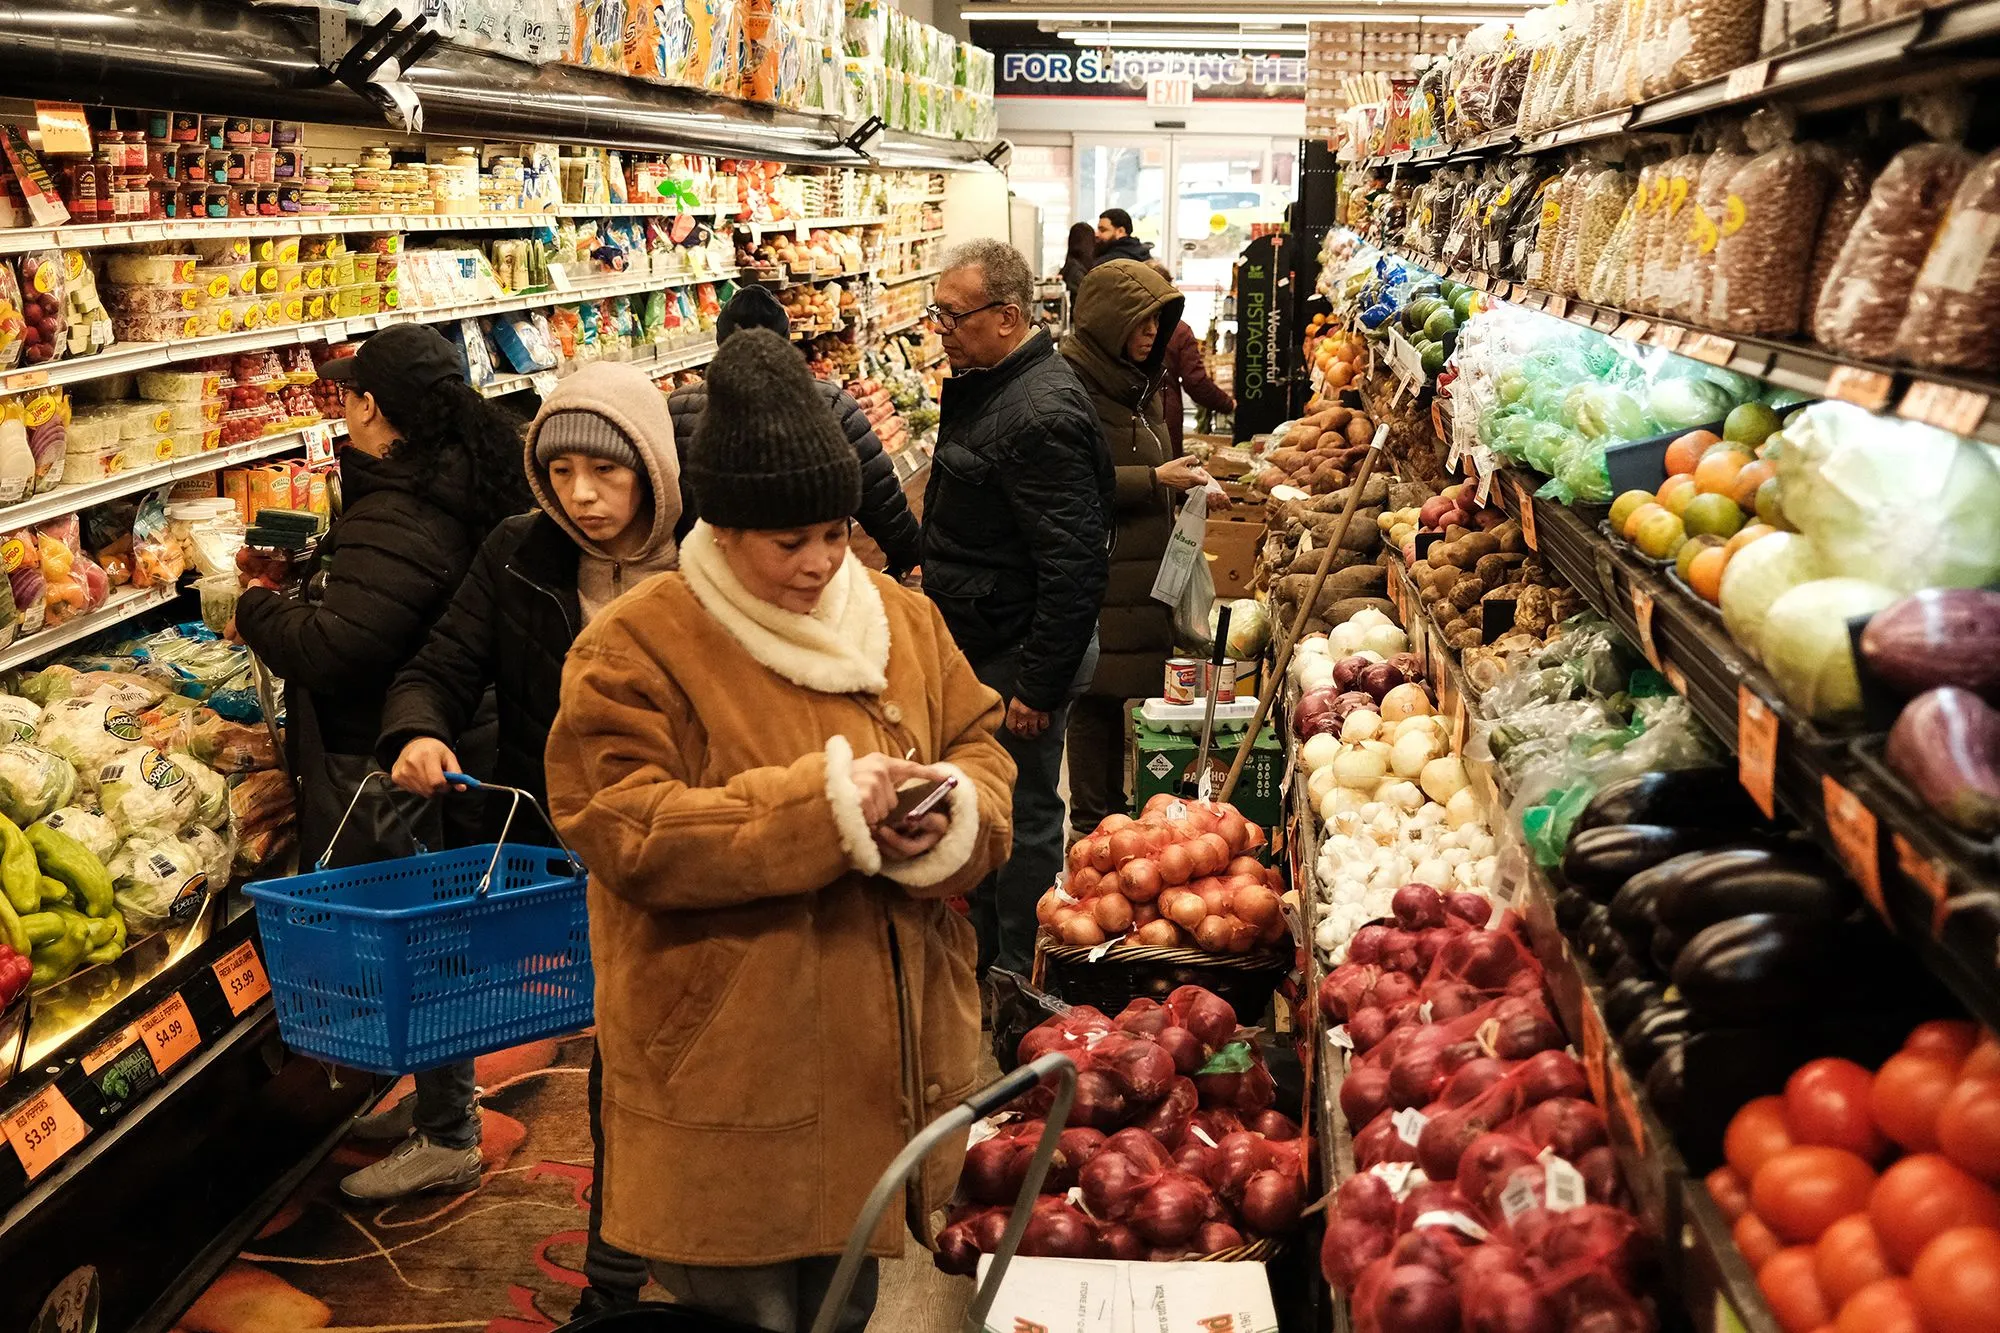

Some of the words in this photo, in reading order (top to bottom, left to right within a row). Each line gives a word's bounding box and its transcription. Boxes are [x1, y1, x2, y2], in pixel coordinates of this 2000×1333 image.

[1005, 55, 1071, 82] FOR
[1077, 54, 1247, 84] SHOPPING
[1252, 56, 1307, 84] HE
[1153, 79, 1189, 105] EXIT
[1245, 292, 1265, 399] PISTACHIOS
[1265, 309, 1281, 384] Wonderful
[32, 403, 51, 421] JUMBO
[1173, 533, 1197, 548] OPEN
[230, 969, 255, 996] $3.99
[163, 999, 182, 1017] PEPPERS
[156, 1020, 182, 1048] $4.99
[25, 1098, 48, 1120] PEPPERS
[24, 1115, 57, 1151] $3.99
[1079, 1281, 1089, 1306] STORE
